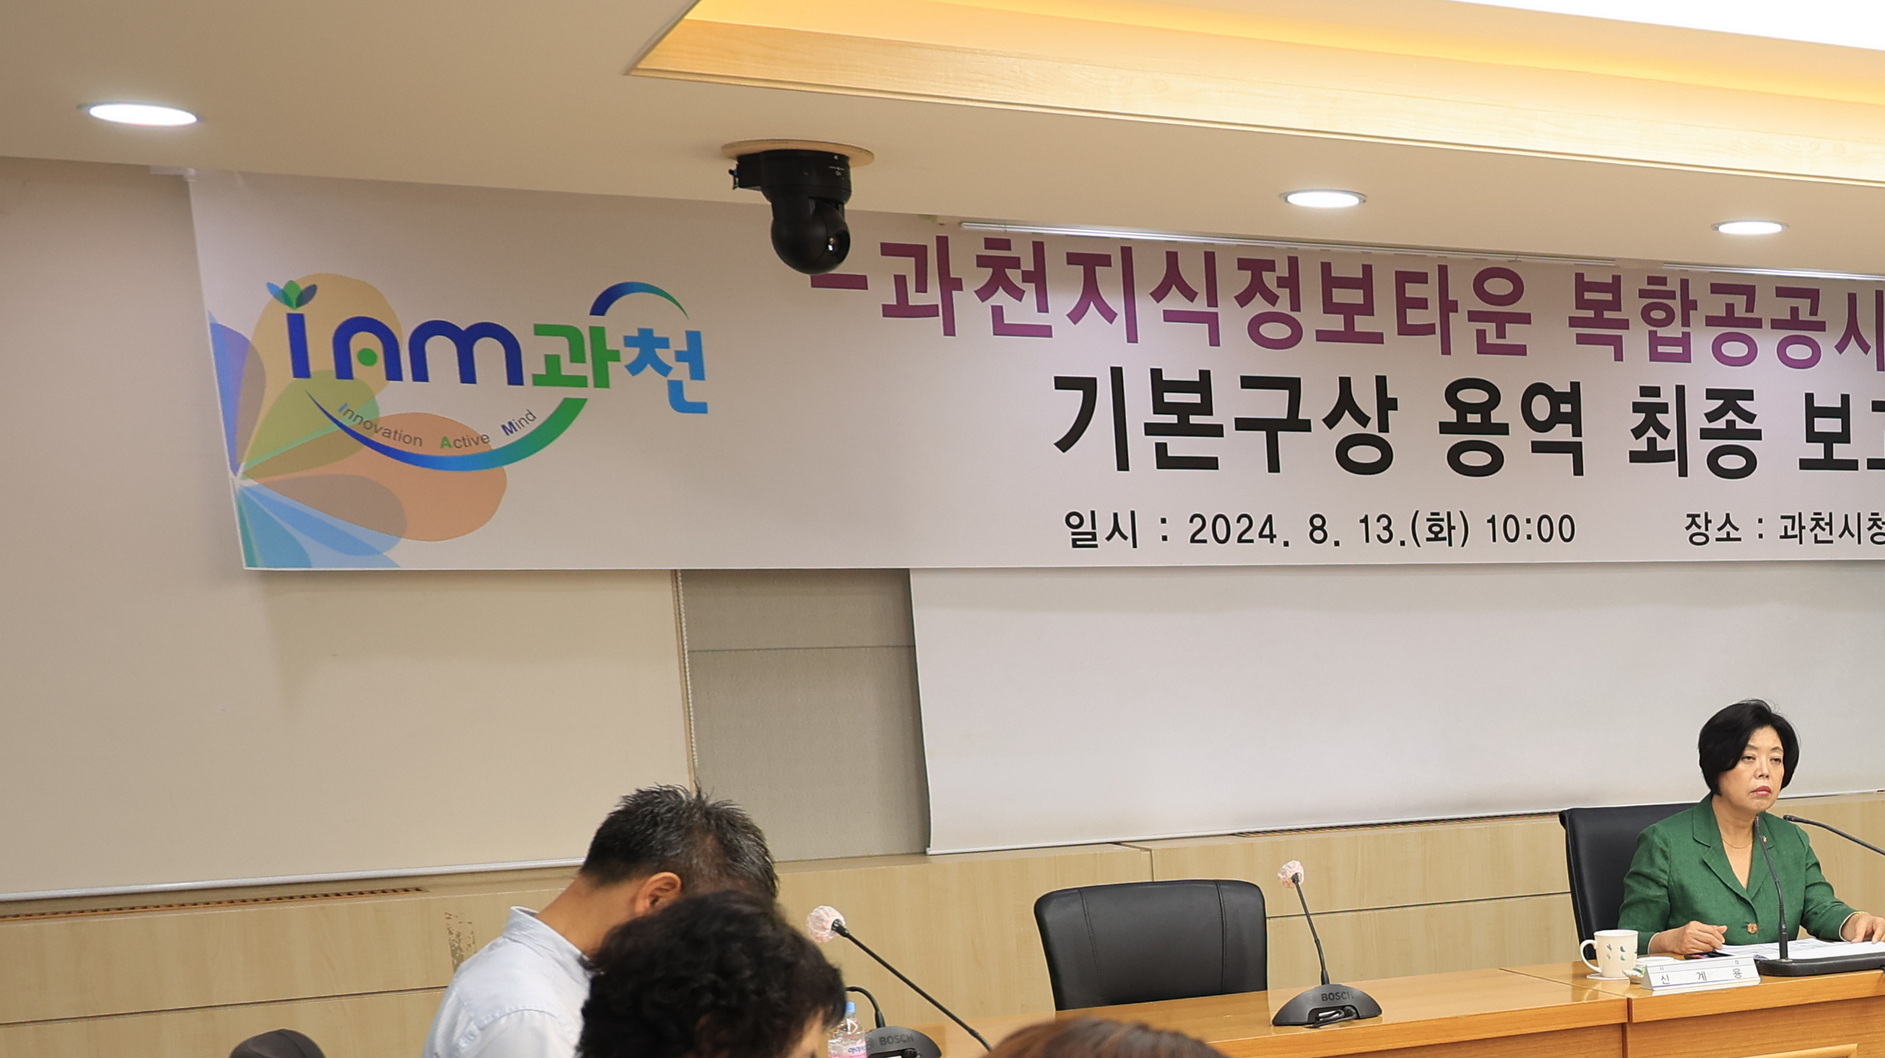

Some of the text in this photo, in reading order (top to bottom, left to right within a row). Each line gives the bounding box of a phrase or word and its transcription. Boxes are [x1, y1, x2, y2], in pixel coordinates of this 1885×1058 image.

[337, 403, 537, 449] Innovation Active Mind
[1053, 366, 1399, 476] 기본구상
[1438, 377, 1585, 478] 용역
[1628, 384, 1763, 480] 최종
[1063, 510, 1138, 549] 일시
[1188, 513, 1289, 548] 2024.
[1308, 513, 1340, 548] 8.
[1486, 514, 1576, 544] 10:00
[1685, 511, 1742, 546] 장소
[1321, 991, 1354, 1002] BOSCH
[879, 1035, 914, 1047] BOSCH
